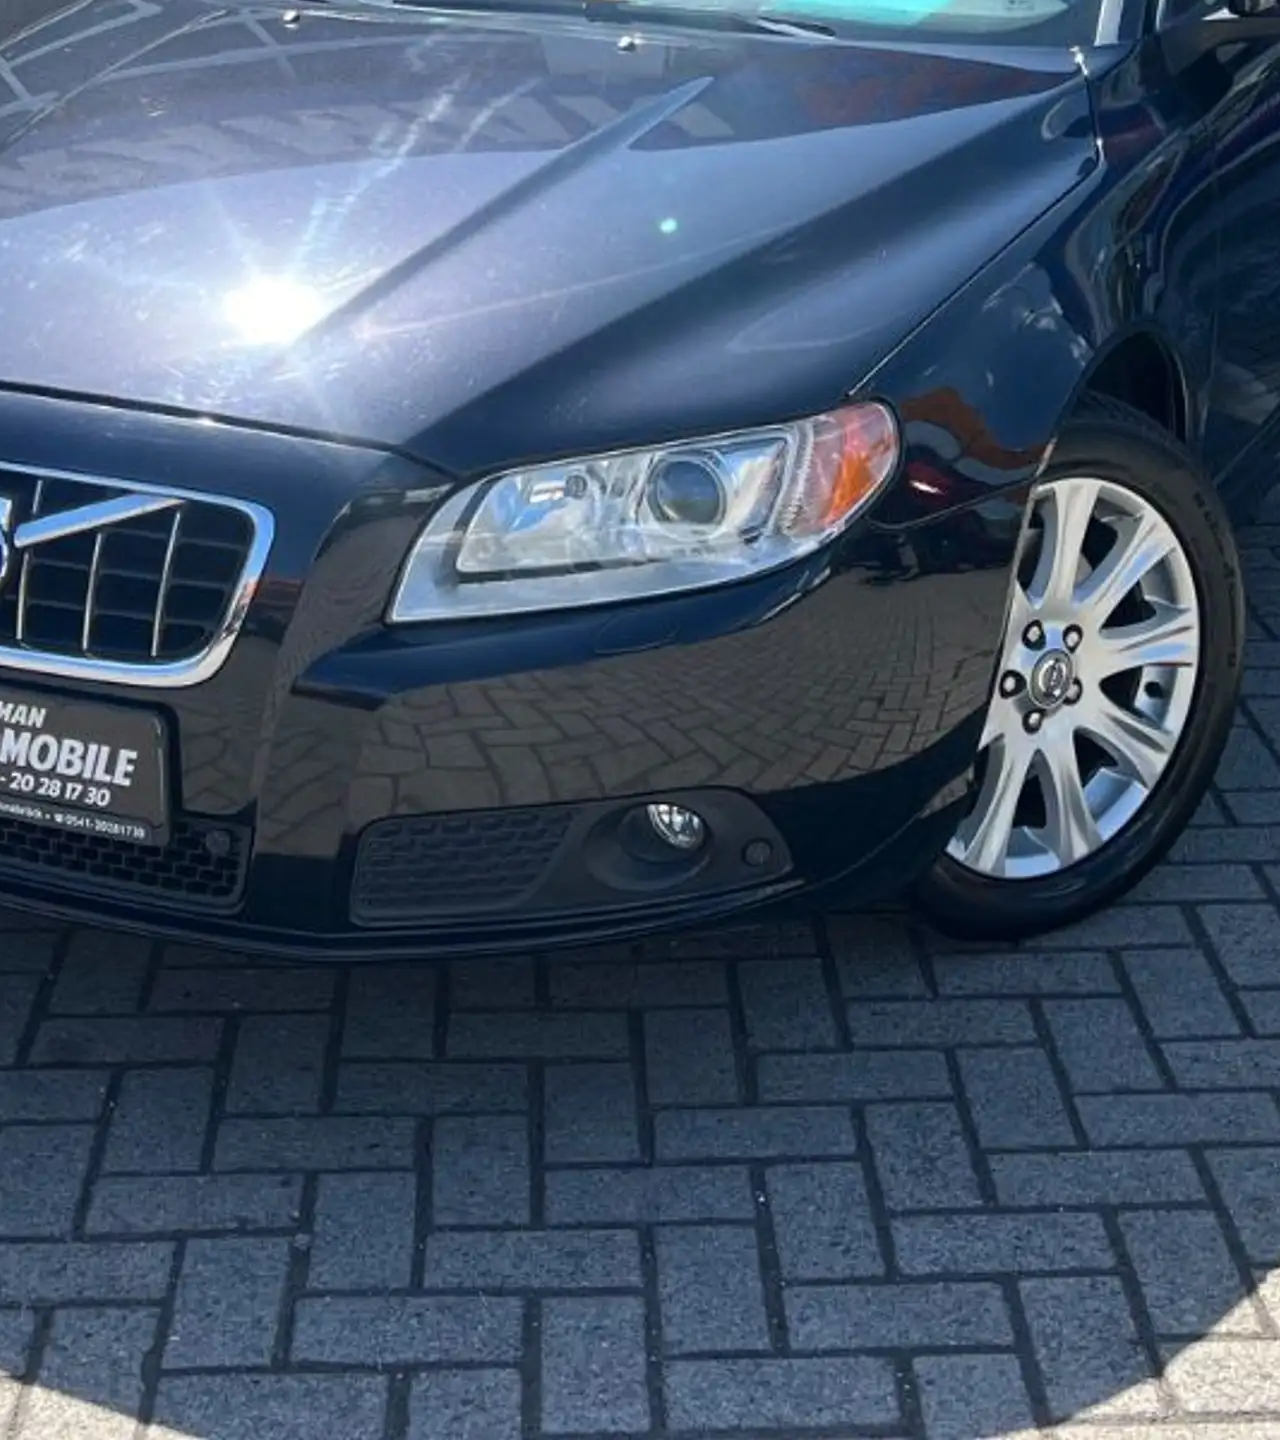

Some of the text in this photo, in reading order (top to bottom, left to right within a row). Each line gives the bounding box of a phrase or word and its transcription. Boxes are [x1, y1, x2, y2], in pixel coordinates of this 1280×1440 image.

[9, 772, 35, 792] 20
[36, 777, 61, 797] 28
[64, 783, 83, 801] 17
[84, 788, 111, 808] 30
